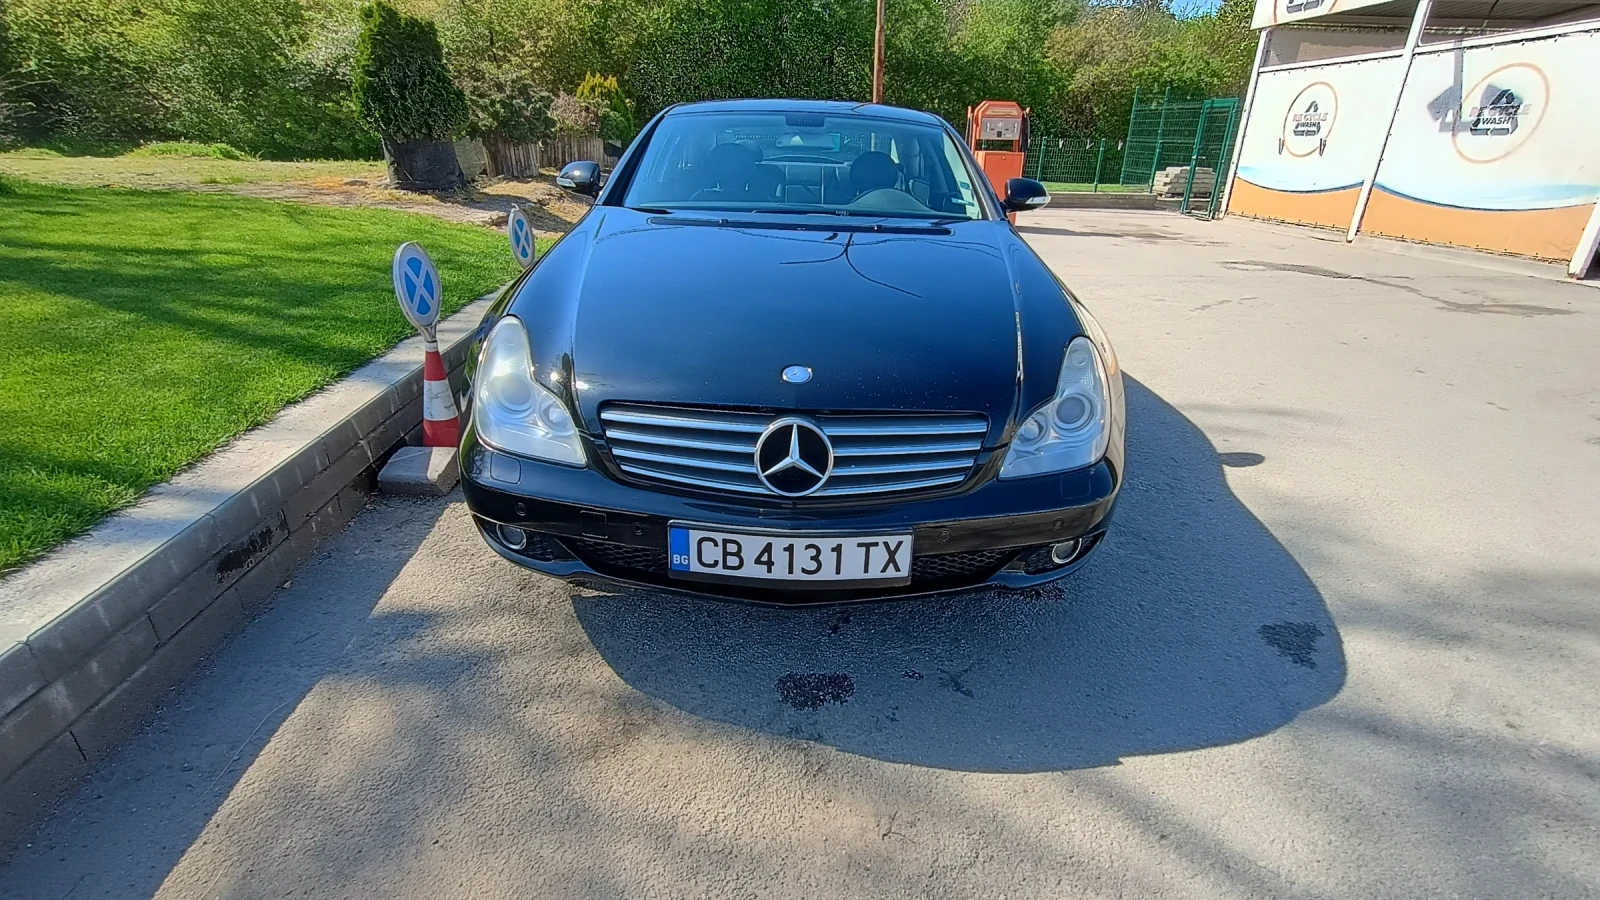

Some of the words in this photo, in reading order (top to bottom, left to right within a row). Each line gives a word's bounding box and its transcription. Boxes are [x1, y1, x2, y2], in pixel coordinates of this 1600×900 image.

[1481, 117, 1511, 125] WASH
[673, 554, 689, 565] BG
[697, 536, 745, 571] CB
[754, 542, 843, 575] 4131
[857, 540, 904, 573] TX
